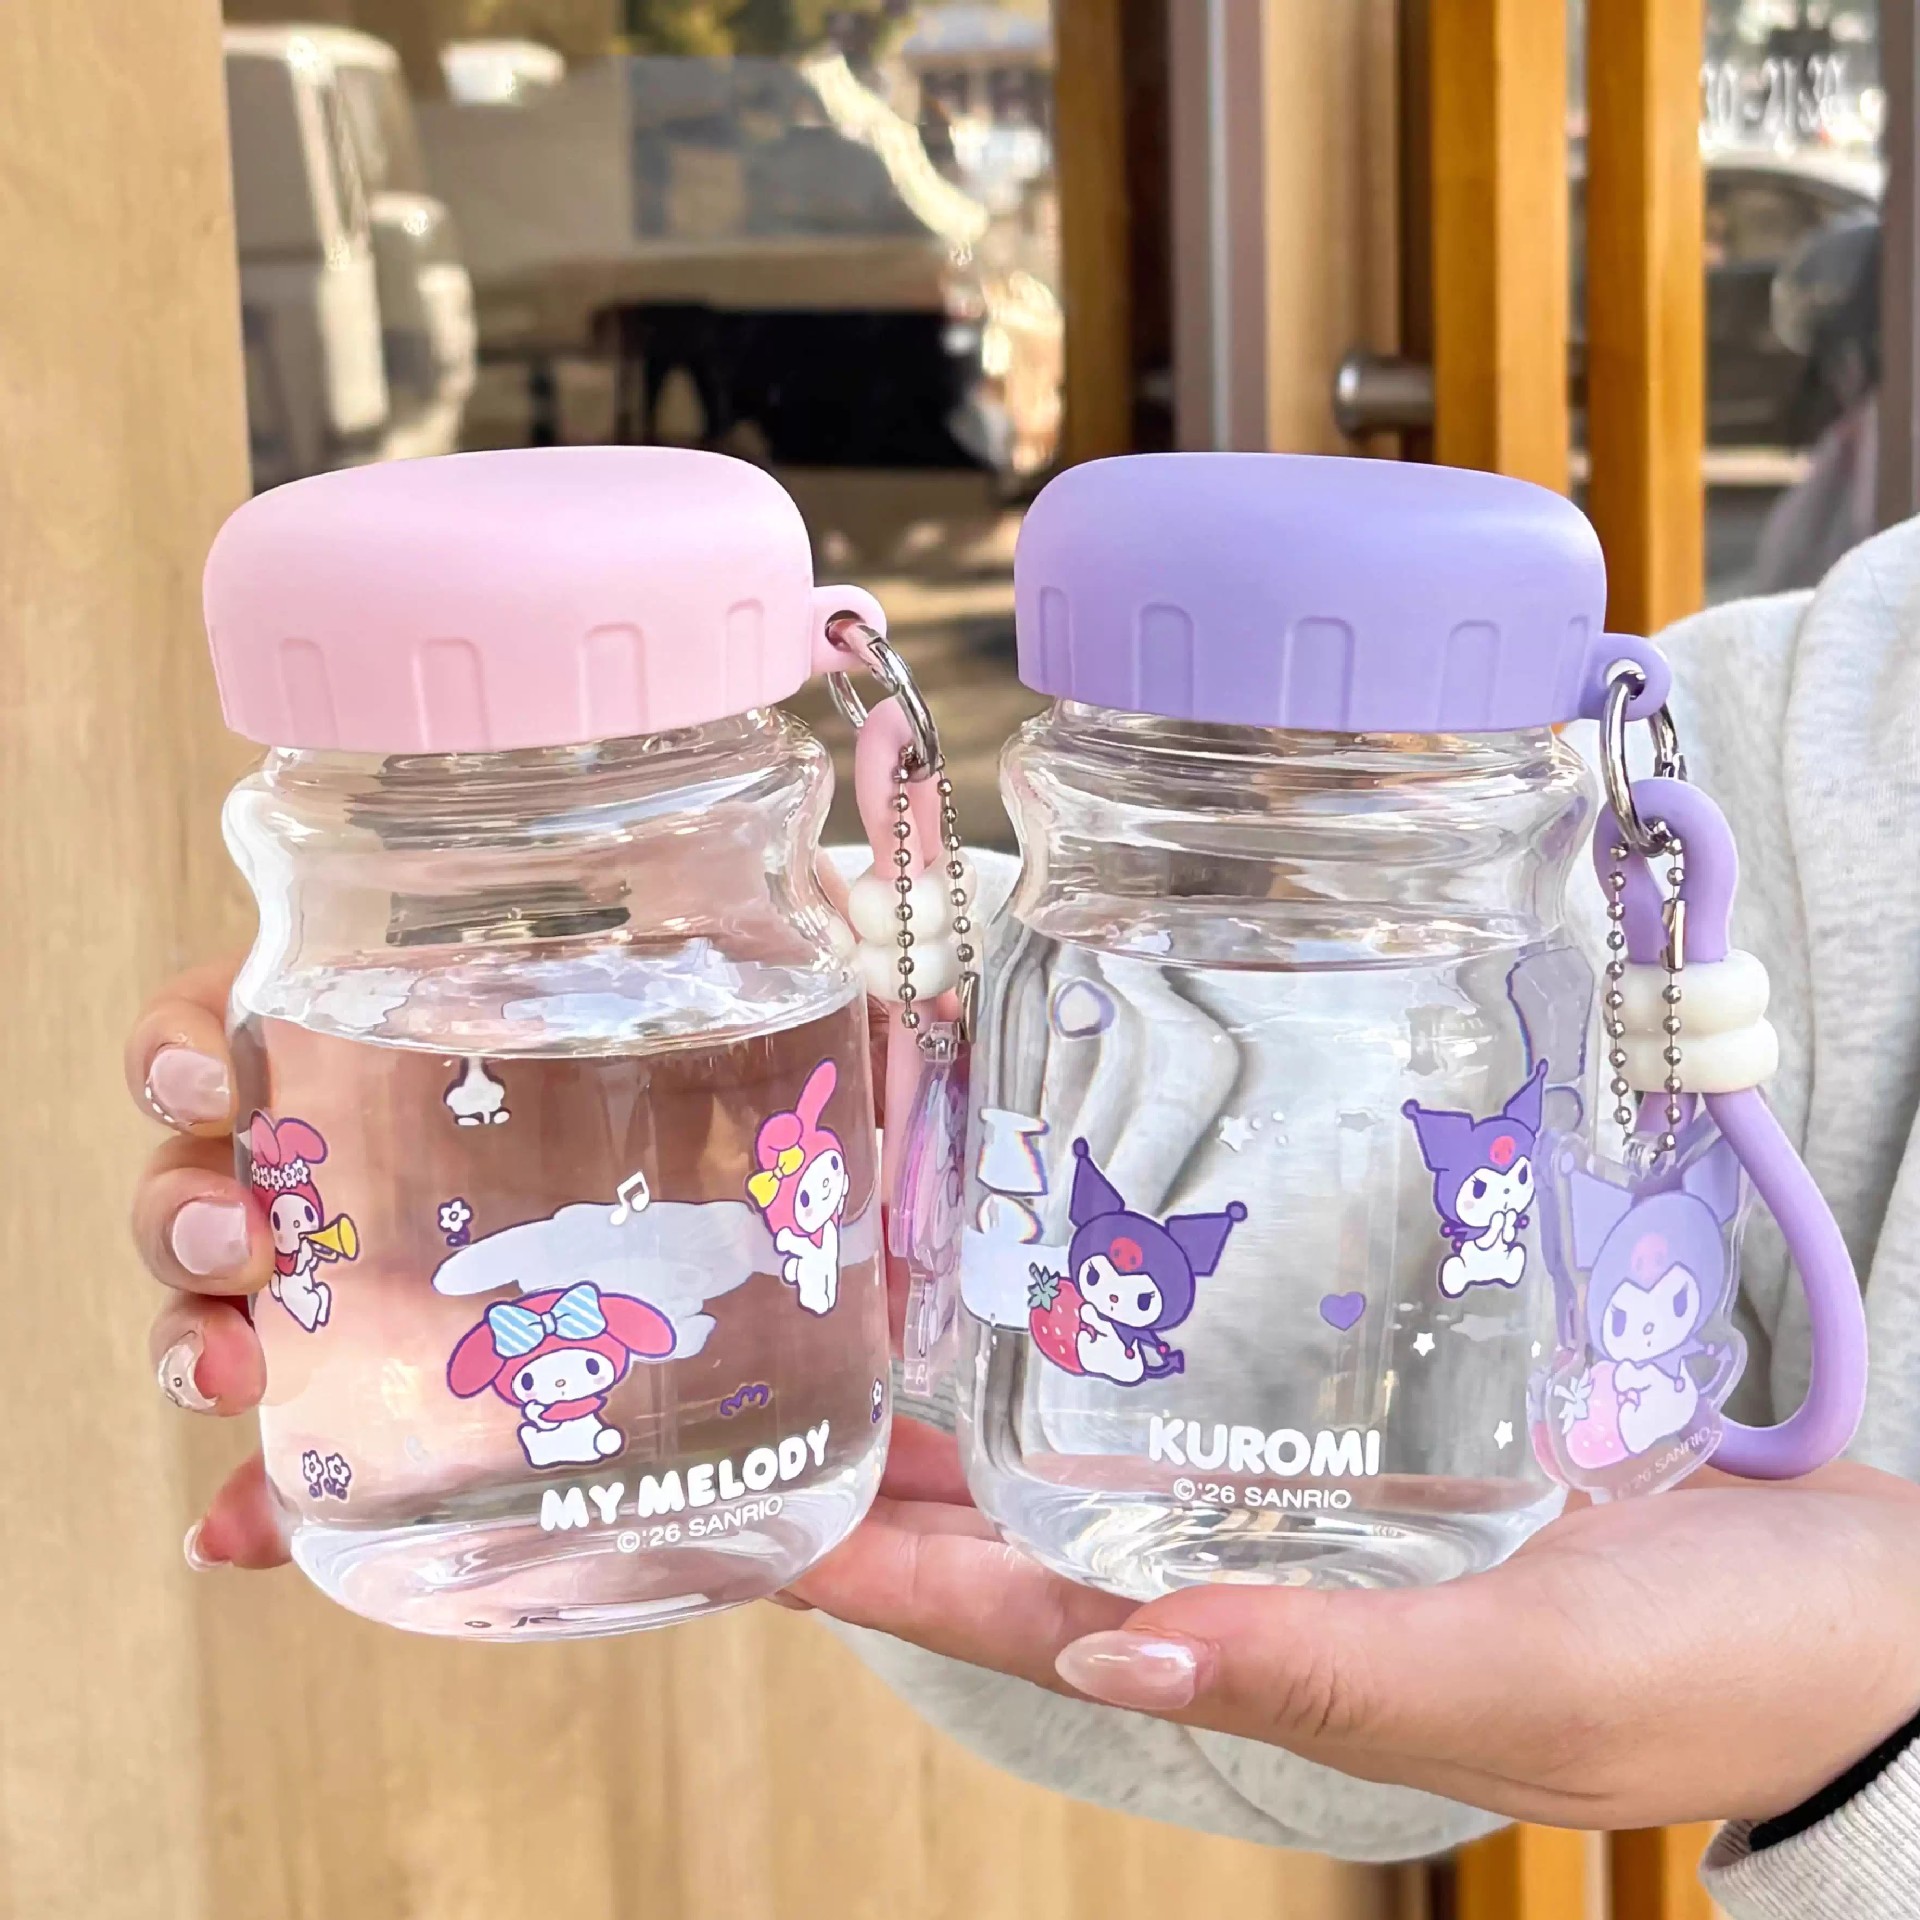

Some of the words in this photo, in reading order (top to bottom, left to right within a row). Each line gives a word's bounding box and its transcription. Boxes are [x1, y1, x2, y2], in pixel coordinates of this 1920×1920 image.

[1149, 1416, 1381, 1477] KUROMI
[540, 1482, 625, 1532] MY
[637, 1419, 831, 1518] MELODY
[1244, 1487, 1352, 1509] SANRIO
[688, 1496, 784, 1538] SANRIO
